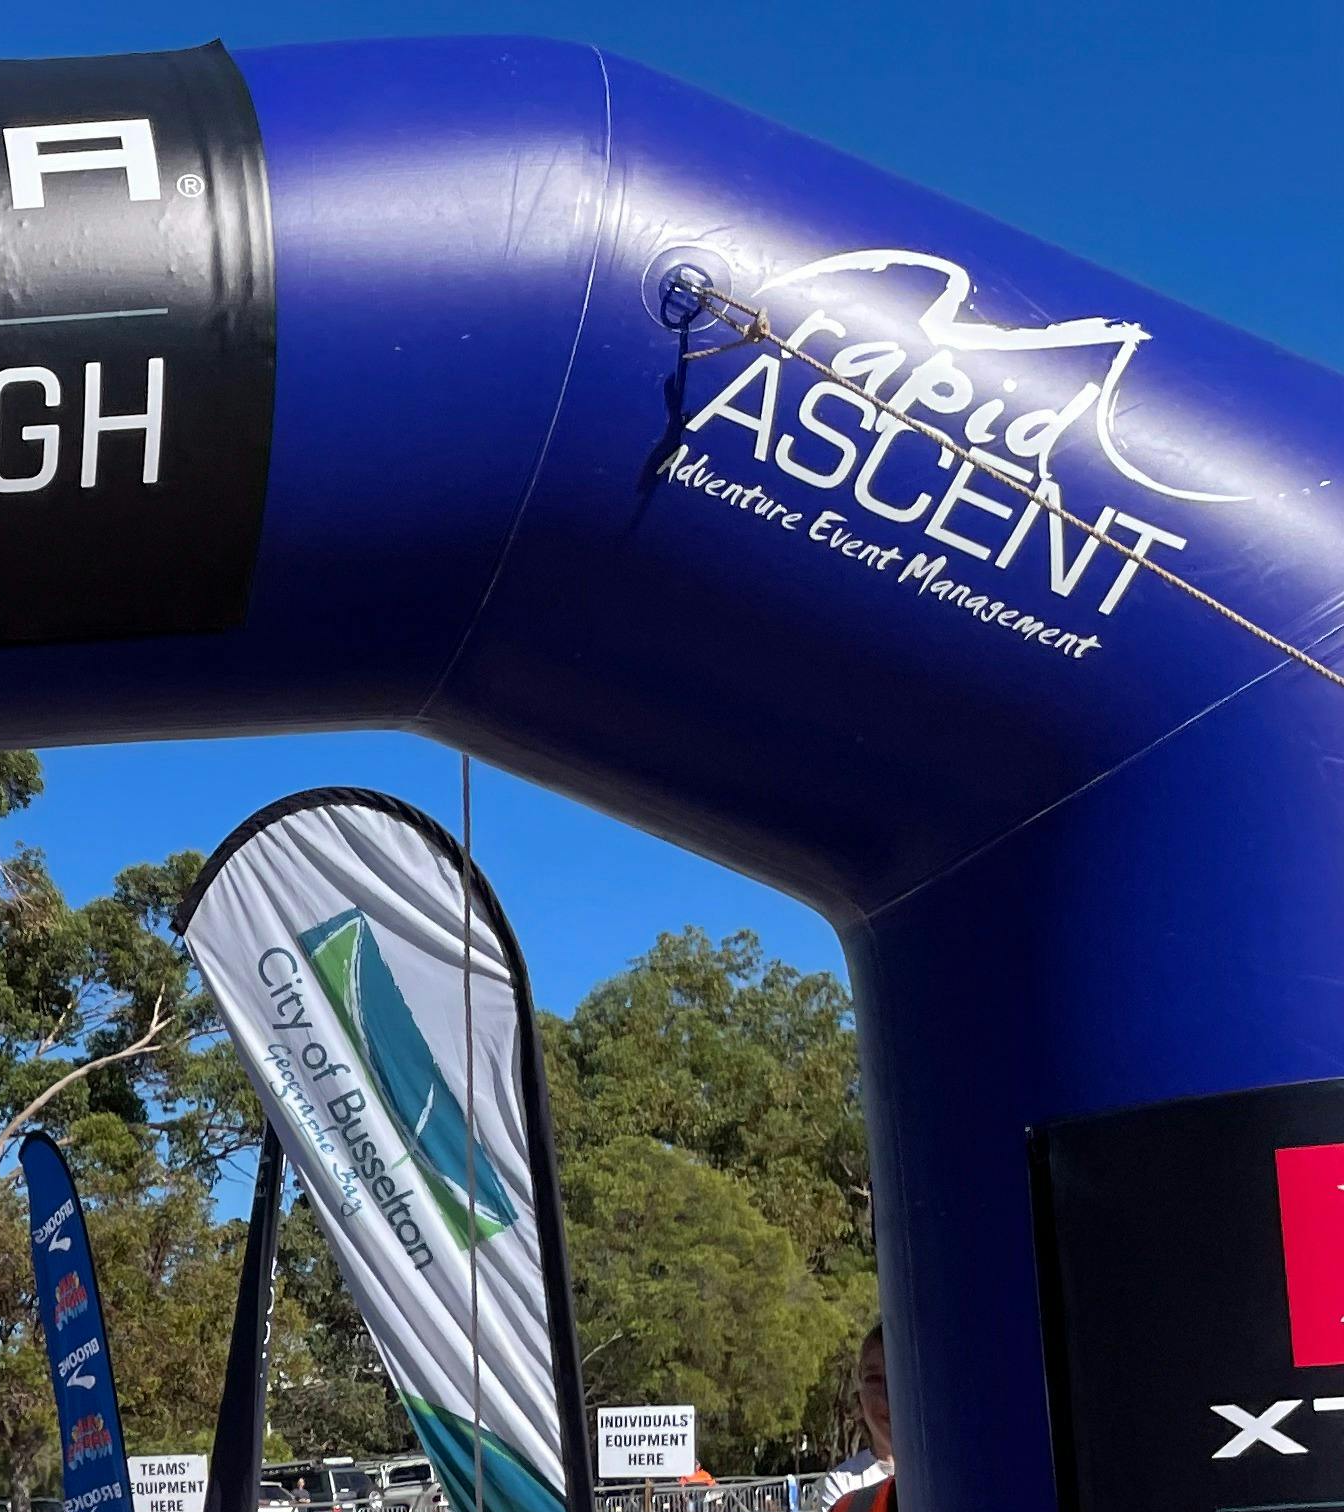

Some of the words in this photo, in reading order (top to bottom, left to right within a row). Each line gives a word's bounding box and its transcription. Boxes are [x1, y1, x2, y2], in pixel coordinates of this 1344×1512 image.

[686, 352, 1187, 616] ASCENT
[657, 445, 803, 532] Adventure
[808, 511, 905, 572] Event
[897, 552, 1103, 659] Management
[257, 946, 313, 1031] City
[301, 1041, 352, 1082] of
[326, 1088, 435, 1271] Busselton
[600, 1414, 693, 1429] INDIVIDUALS'
[605, 1433, 688, 1448] EQUIPMENT
[628, 1452, 665, 1467] HERE
[140, 1462, 190, 1477] TEAMS'
[130, 1480, 205, 1496] EQUIPMENT
[150, 1499, 184, 1512] HERE
